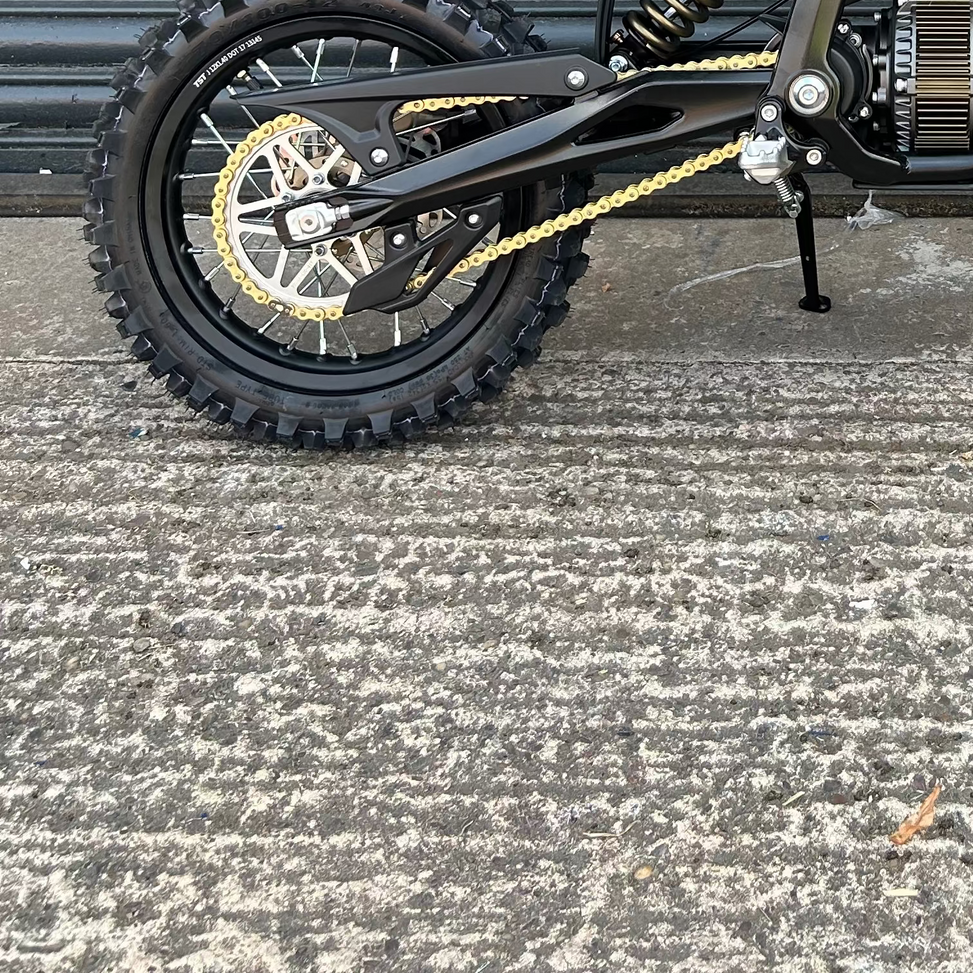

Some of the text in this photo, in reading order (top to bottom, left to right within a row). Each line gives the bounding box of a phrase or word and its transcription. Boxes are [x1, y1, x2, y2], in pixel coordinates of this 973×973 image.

[192, 72, 207, 88] TST
[228, 47, 240, 60] DOT
[238, 43, 246, 52] 17
